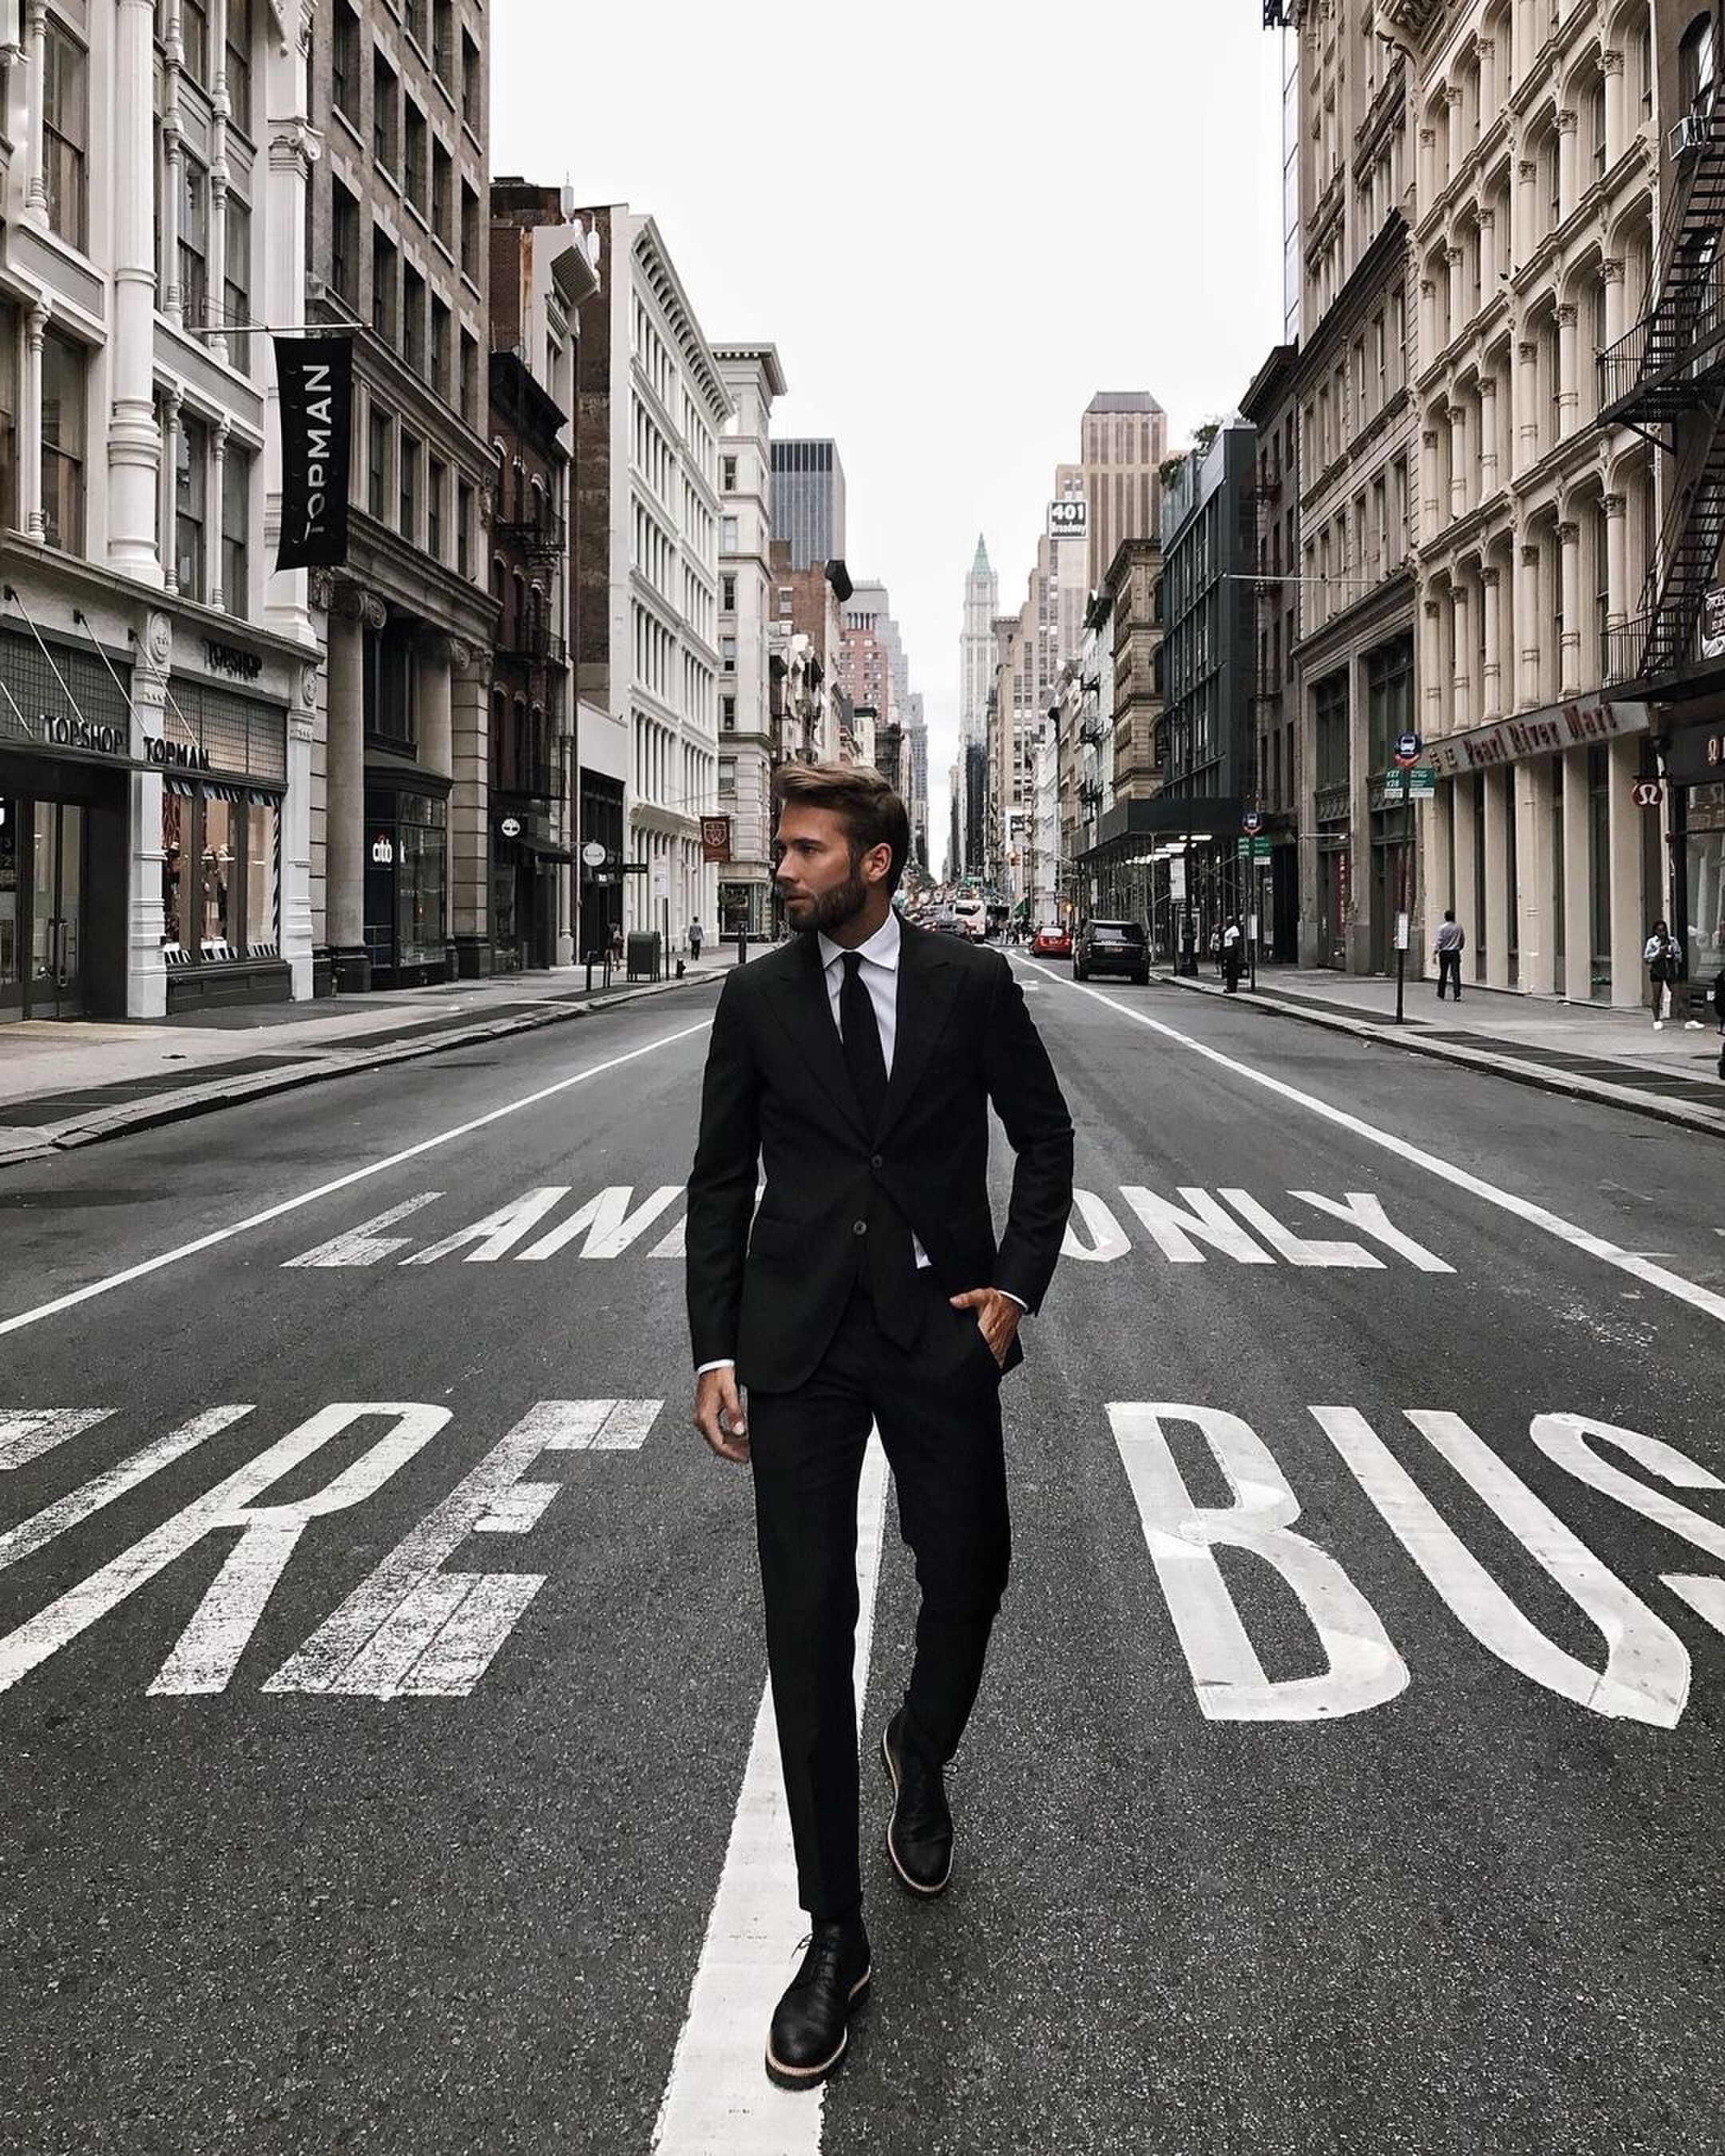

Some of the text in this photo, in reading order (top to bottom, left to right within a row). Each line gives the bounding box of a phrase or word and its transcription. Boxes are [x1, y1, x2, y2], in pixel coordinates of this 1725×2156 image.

[303, 365, 332, 541] TOPMAN
[1052, 504, 1084, 520] 401
[42, 714, 211, 772] TOPSHOP TOPMAN
[1461, 727, 1509, 767] Pearl
[1506, 722, 1560, 755] River
[1562, 704, 1618, 743] Mart
[280, 1186, 690, 1267] LAN
[1060, 1187, 1457, 1273] ONLY
[0, 1399, 664, 1701] IRE
